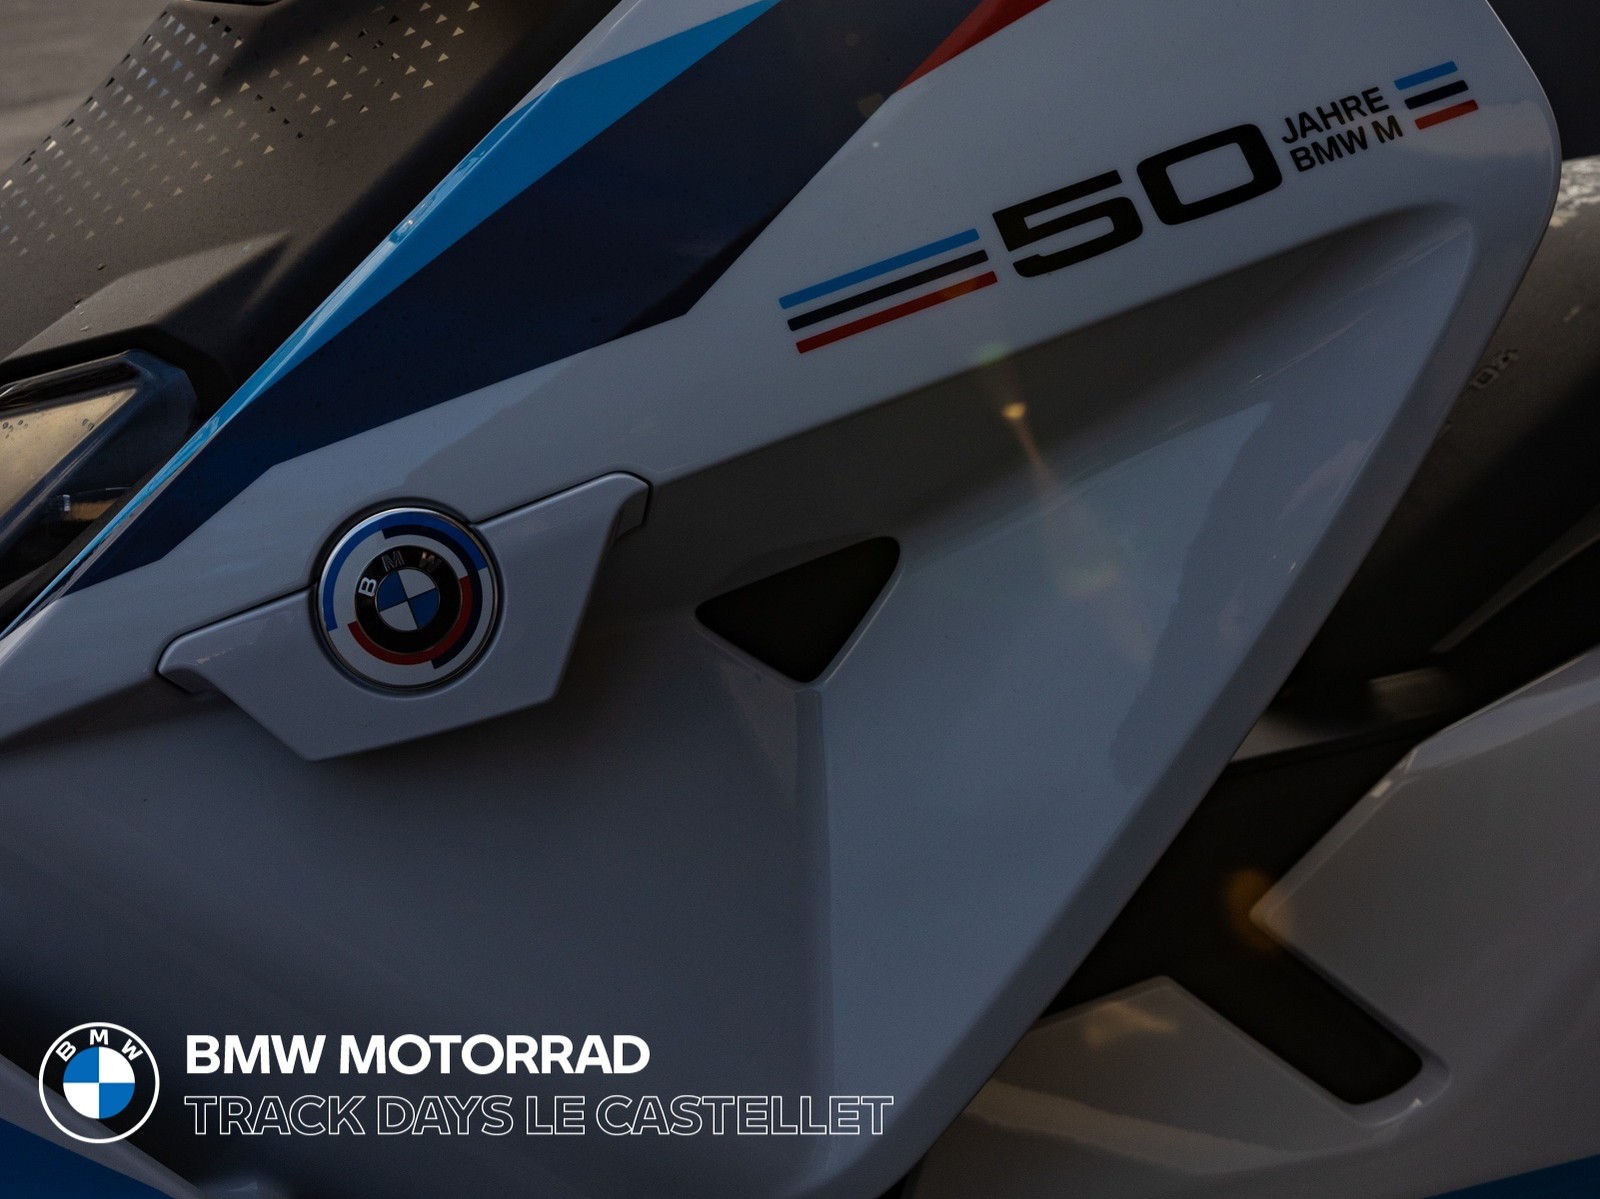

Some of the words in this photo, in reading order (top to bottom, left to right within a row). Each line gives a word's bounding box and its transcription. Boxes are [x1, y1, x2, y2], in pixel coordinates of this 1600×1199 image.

[1282, 86, 1390, 144] JAHRE
[1289, 126, 1368, 173] BMW
[1371, 114, 1403, 144] M
[992, 123, 1283, 278] 50
[358, 550, 442, 598] BMW
